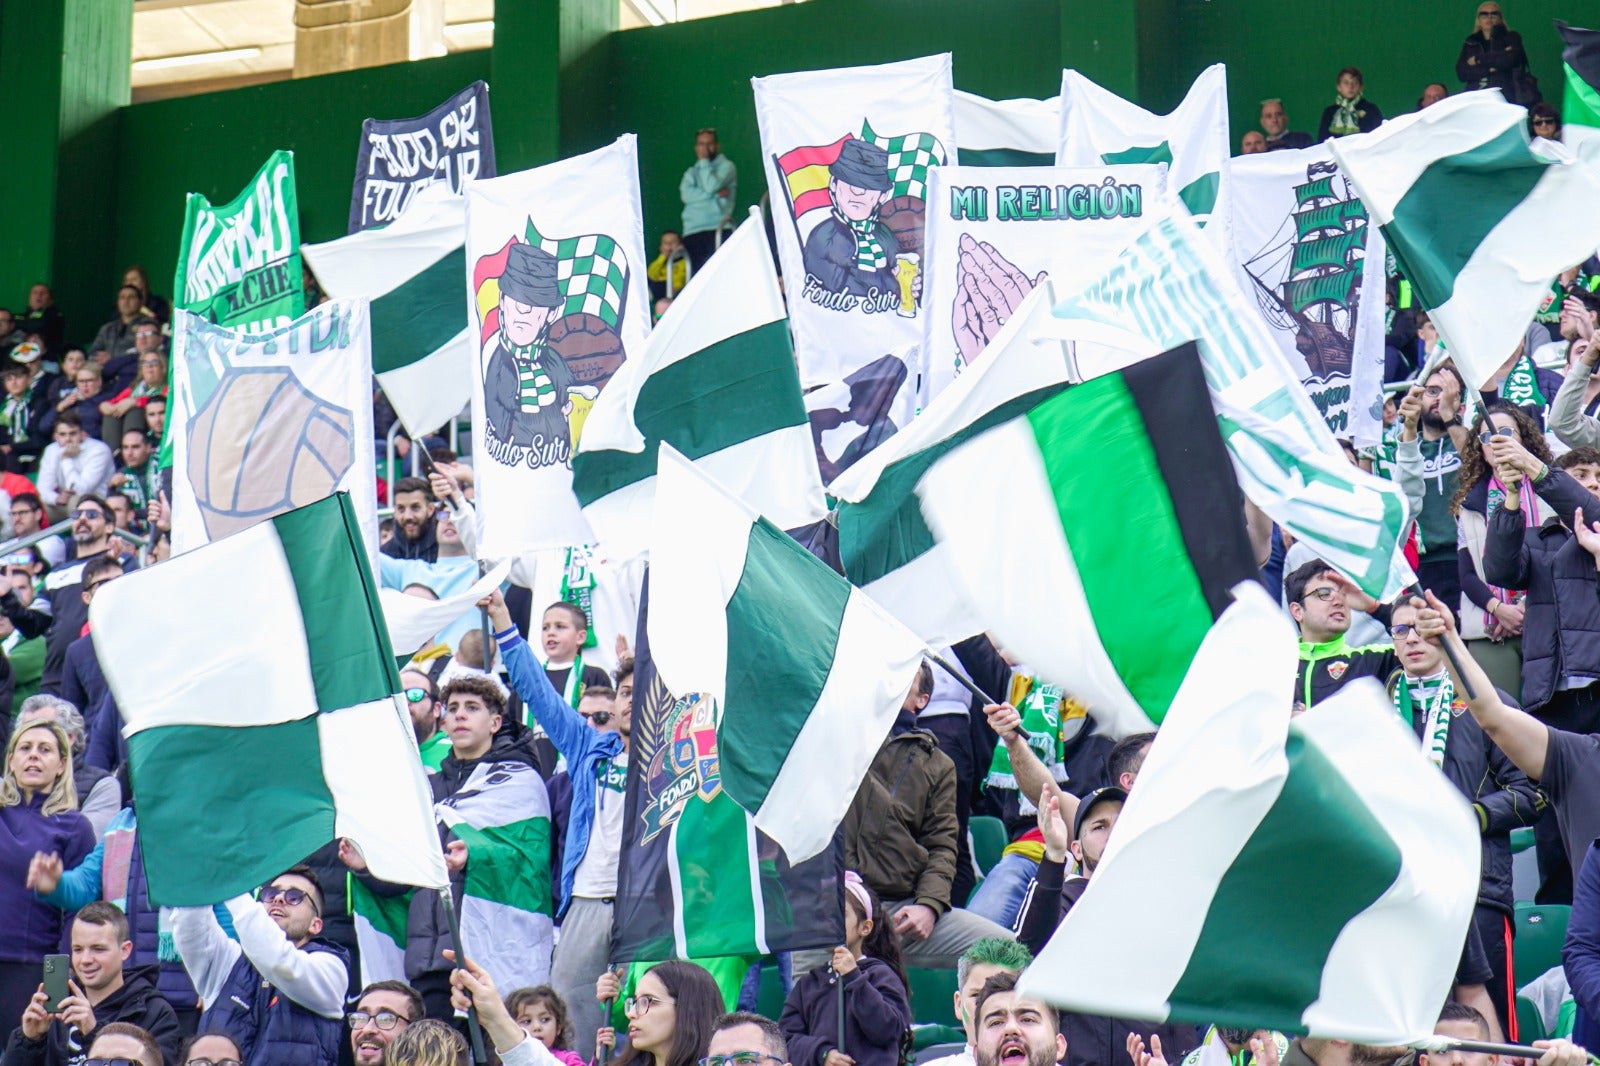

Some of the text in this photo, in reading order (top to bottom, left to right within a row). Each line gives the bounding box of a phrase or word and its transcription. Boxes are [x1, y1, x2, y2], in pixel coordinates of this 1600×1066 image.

[950, 176, 1142, 221] MI RELIGIÓN
[802, 272, 900, 314] Fondo Sur
[484, 417, 569, 470] Fondo Sur
[658, 771, 698, 812] FONDO
